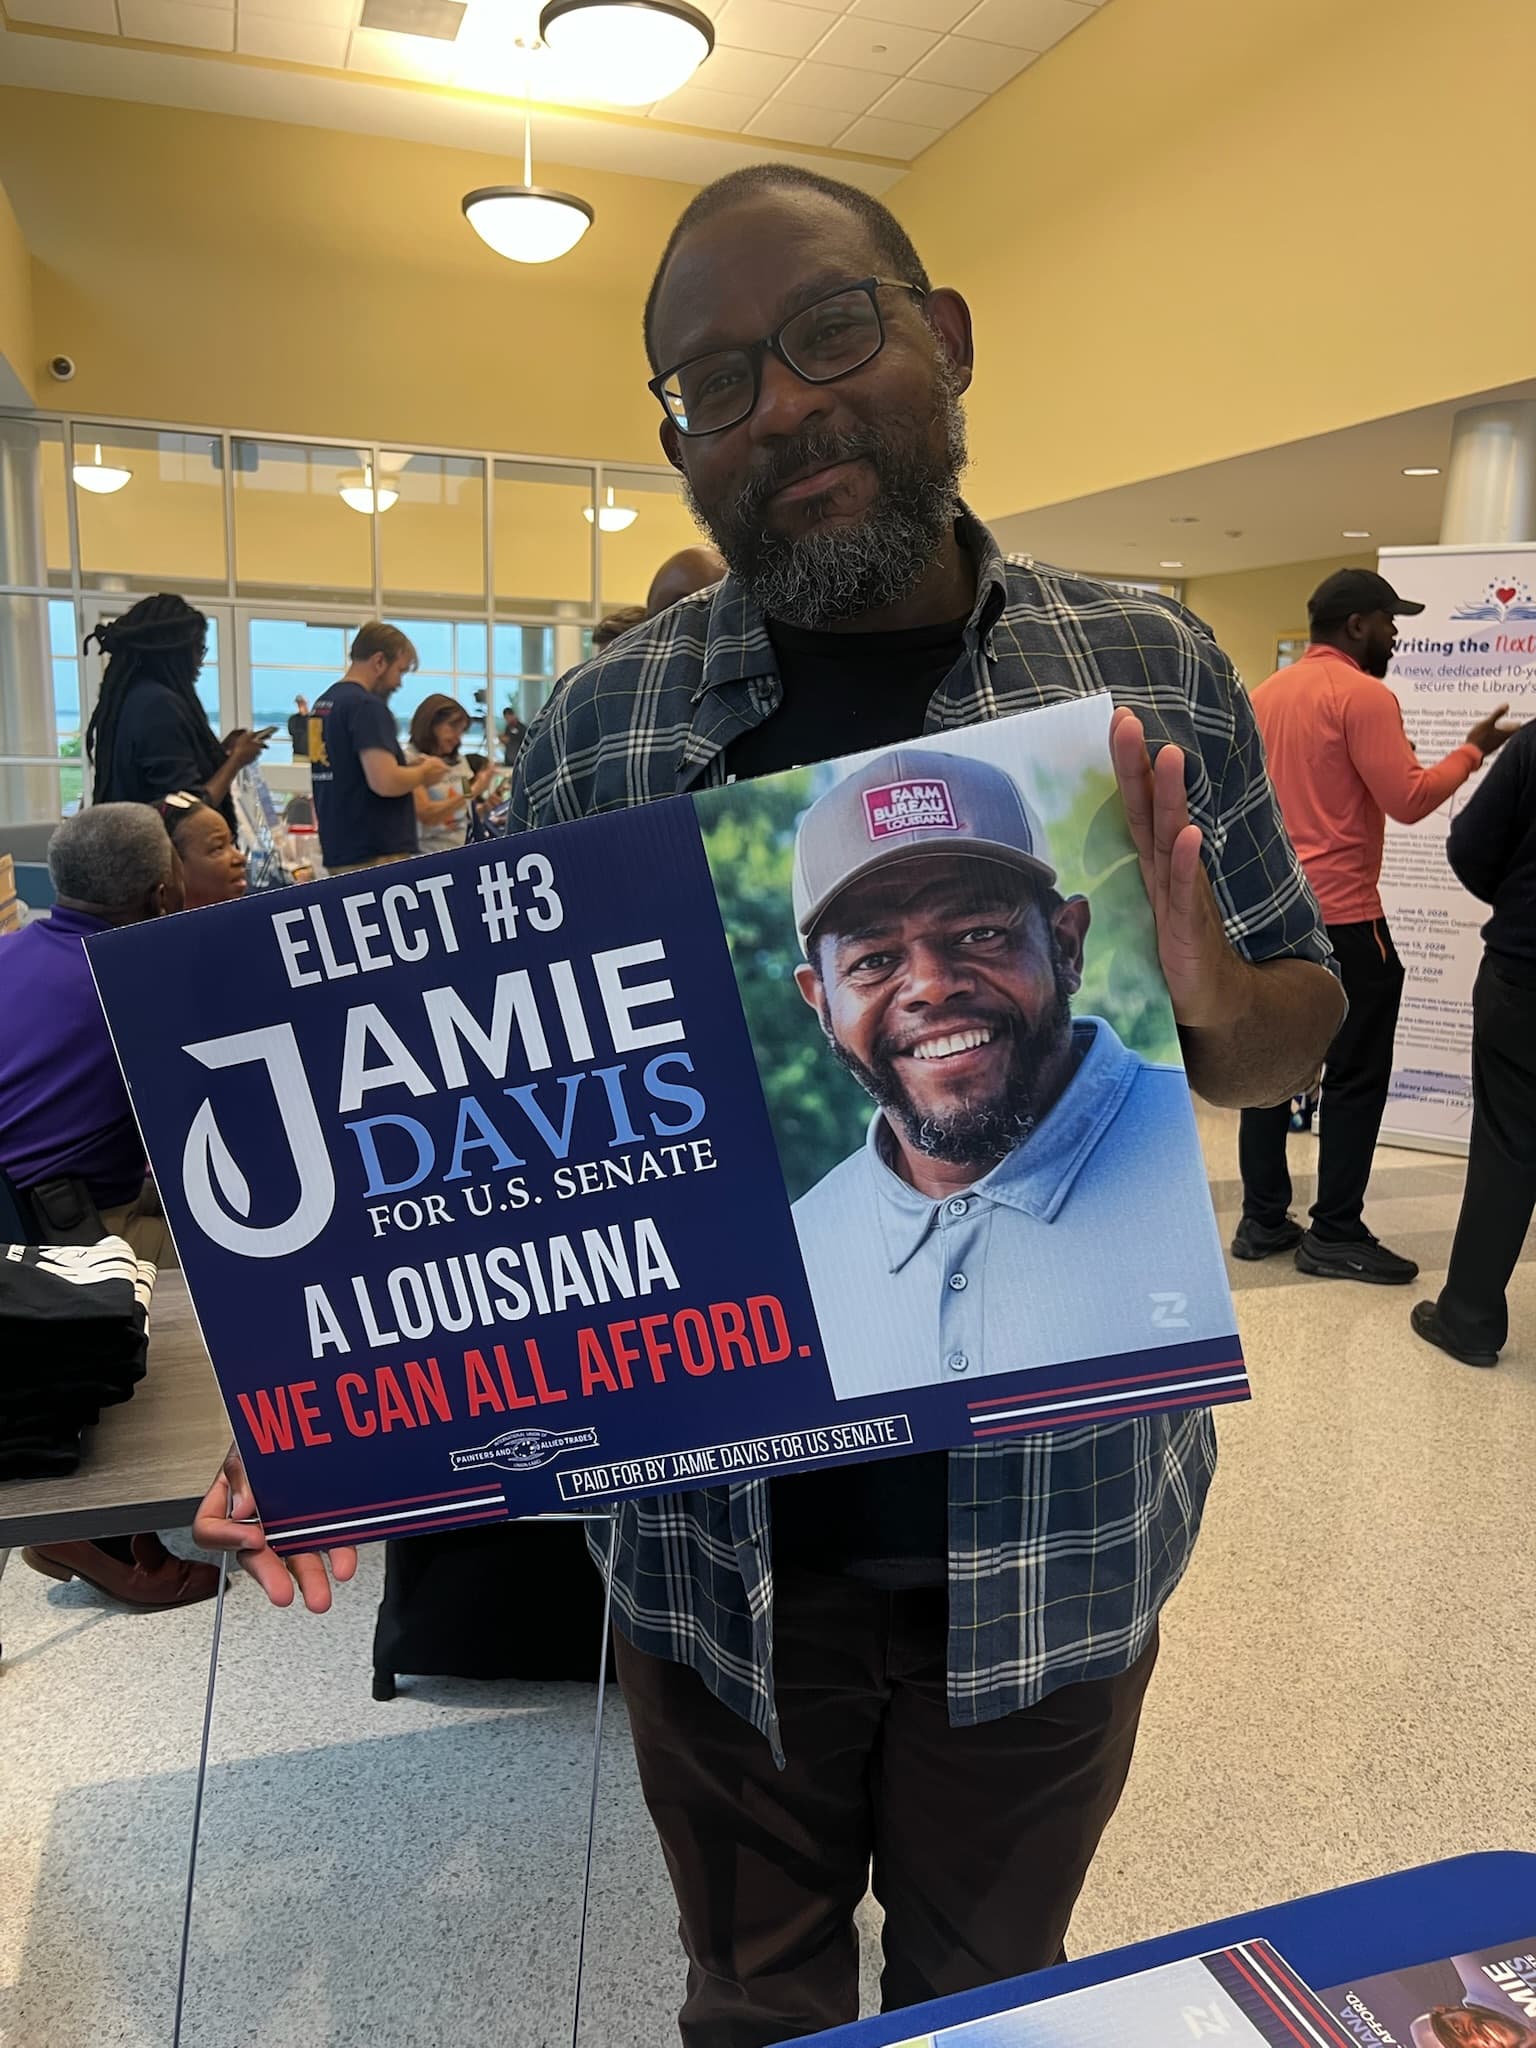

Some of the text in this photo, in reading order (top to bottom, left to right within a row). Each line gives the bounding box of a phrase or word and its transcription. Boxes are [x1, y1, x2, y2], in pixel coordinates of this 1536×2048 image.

[1460, 638, 1490, 653] the
[1392, 664, 1536, 680] A new, dedicated 10-ye
[1413, 681, 1455, 693] secure
[1458, 680, 1479, 692] the
[873, 799, 945, 821] BUREAU
[891, 785, 941, 803] FARM
[886, 815, 950, 831] LOUISIANA
[272, 854, 563, 988] ELECT #3
[344, 1052, 707, 1198] DAVIS
[367, 1139, 717, 1237] FOR U.S. SENATE
[304, 1218, 680, 1358] A LOUISIANA
[238, 1295, 811, 1454] WE CAN ALL AFFORD.
[456, 1433, 593, 1463] PAINTERS AND ALLIED TRADES
[572, 1420, 898, 1494] PAID FOR BY JAMIE DAVIS FOR US SENATE
[1345, 1990, 1398, 2044] AFFORD.
